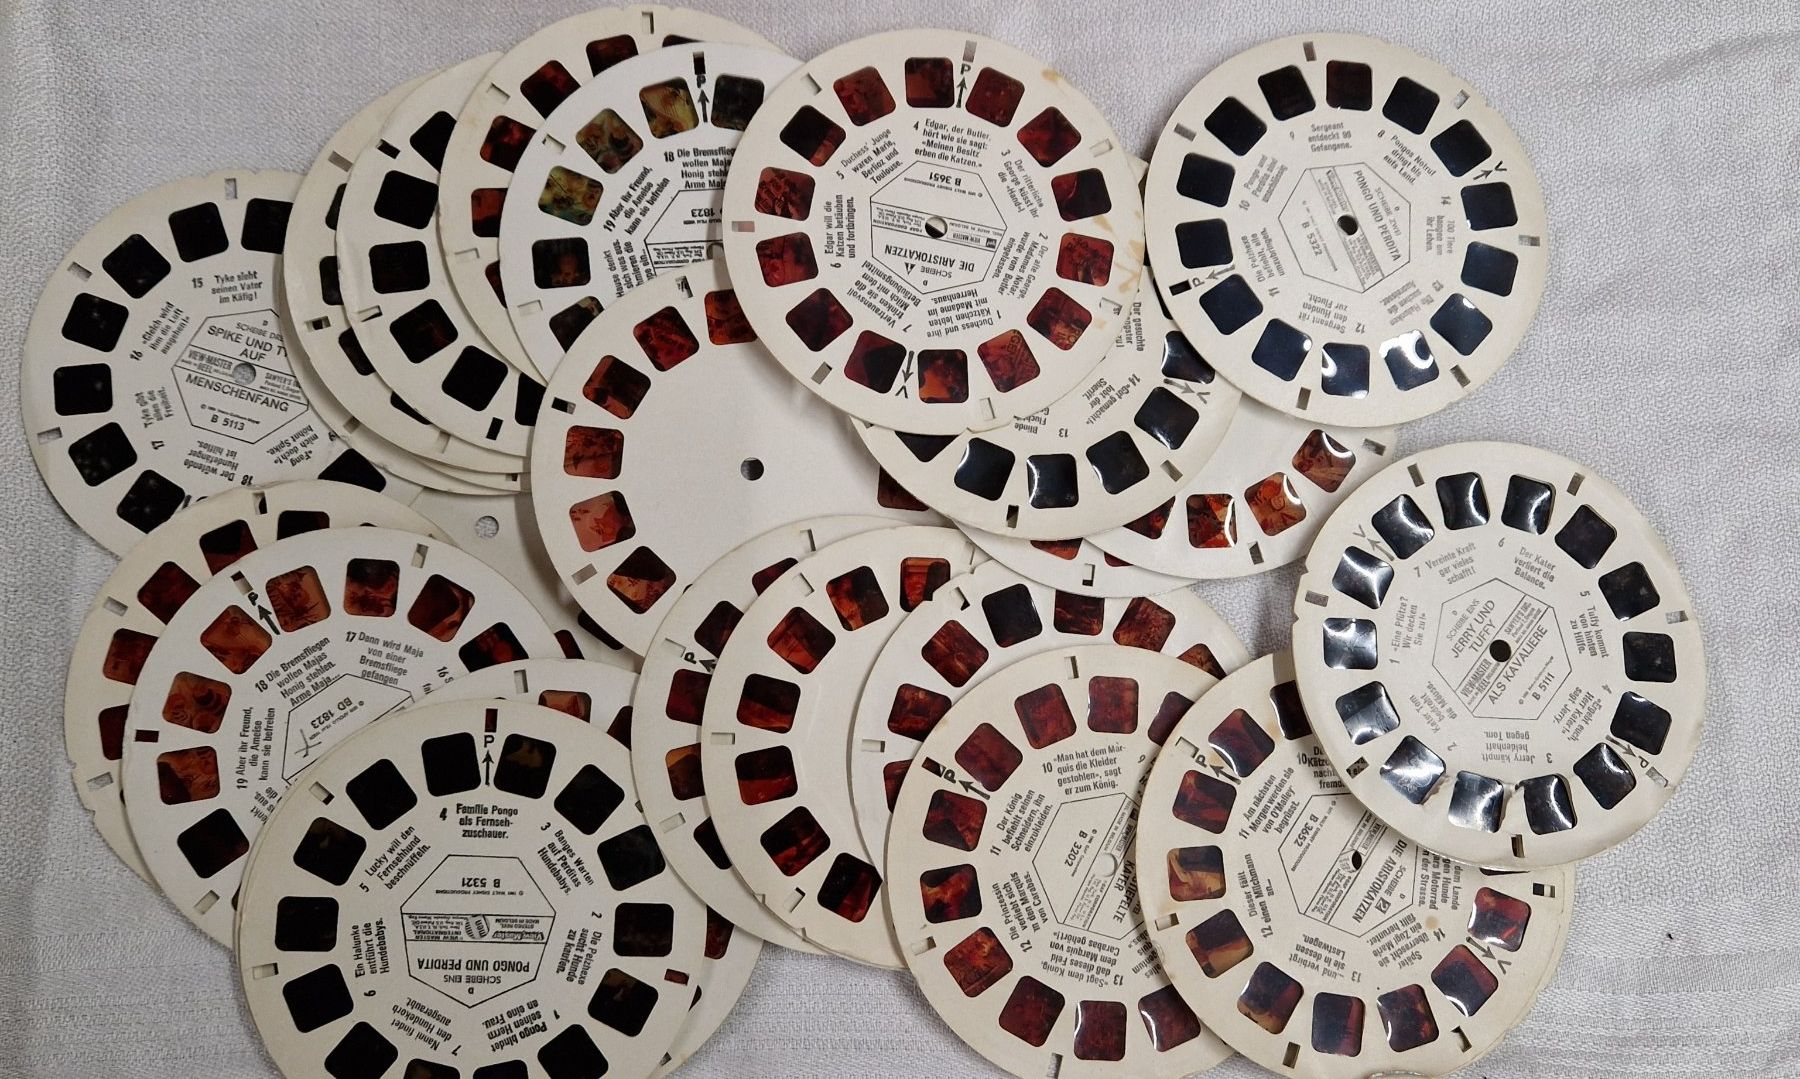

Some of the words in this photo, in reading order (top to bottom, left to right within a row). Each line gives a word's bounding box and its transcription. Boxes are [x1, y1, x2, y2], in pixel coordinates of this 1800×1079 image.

[928, 171, 952, 184] 3651
[954, 177, 961, 186] B
[1353, 169, 1373, 201] PONGO
[1368, 201, 1383, 222] UND
[1377, 223, 1401, 261] PERDITA
[884, 244, 955, 267] ARISTOKATZEN
[920, 265, 952, 278] SCHEIBE
[958, 260, 974, 272] DIE
[854, 279, 866, 291] die
[860, 259, 921, 307] Betäubungsmittel
[861, 272, 878, 286] dem
[866, 288, 878, 299] sie
[876, 282, 890, 295] mit
[889, 292, 910, 311] Milch
[930, 288, 978, 304] Herrenhaus.
[974, 296, 987, 307] mit
[846, 287, 896, 328] Vertrauensvoll
[878, 297, 904, 319] trinken
[927, 307, 938, 316] im
[939, 300, 973, 313] Madame
[955, 306, 991, 320] Kätzchen
[928, 315, 953, 326] lebten
[996, 309, 1001, 319] 1
[902, 323, 912, 332] 7
[944, 324, 959, 335] und
[961, 317, 993, 330] Duchess
[926, 328, 942, 337] ihre
[1451, 623, 1476, 658] JERRY
[1473, 599, 1494, 624] UND
[1468, 618, 1495, 652] TUFFY
[1488, 681, 1506, 704] ALS
[1502, 624, 1547, 682] KAVALIERE
[484, 735, 495, 748] P
[439, 807, 447, 820] 4
[455, 802, 488, 814] Familie
[490, 804, 518, 817] Pongo
[1001, 814, 1022, 845] befiehlt
[1018, 789, 1035, 814] seinen
[458, 815, 472, 825] als
[989, 845, 1001, 855] 11
[995, 815, 1009, 831] Der
[1003, 792, 1022, 815] König
[1010, 808, 1039, 851] Schneidern,
[1032, 793, 1045, 807] ihn
[461, 827, 508, 838] zuschauer.
[1023, 804, 1053, 852] einzukleiden.
[1078, 829, 1088, 838] B
[1064, 841, 1082, 866] 3202
[1391, 838, 1407, 857] DIE
[358, 882, 369, 892] 5
[364, 853, 388, 876] Lucky
[386, 838, 401, 854] will
[400, 825, 415, 840] den
[376, 834, 421, 881] Fernsehhund
[384, 844, 431, 889] beschnüffeln.
[461, 877, 486, 887] 5321
[493, 878, 500, 888] B
[1351, 855, 1396, 923] ARISTOKATZEN
[361, 922, 372, 936] die
[350, 924, 362, 960] Halunke
[374, 917, 389, 974] Hundebabys.
[363, 937, 377, 974] entführt
[354, 962, 365, 978] Ein
[417, 957, 461, 970] PERDITA
[465, 959, 488, 971] UND
[492, 960, 529, 972] PONGO
[443, 974, 462, 983] EINS
[465, 974, 501, 984] SCHEIBE
[363, 989, 376, 997] 6
[405, 996, 451, 1026] ausgeraubt.
[506, 1004, 525, 1018] eine
[526, 999, 538, 1009] an
[391, 1004, 435, 1034] Hundekorb
[481, 1013, 506, 1028] Frau.
[512, 1010, 541, 1028] seinen
[553, 1009, 560, 1020] 1
[390, 1018, 414, 1036] findet
[486, 1023, 513, 1040] Herrn
[518, 1020, 547, 1039] Pongo
[414, 1031, 440, 1051] Nanni
[435, 1027, 452, 1042] den
[490, 1033, 518, 1052] bindet
[451, 1044, 461, 1056] 7
